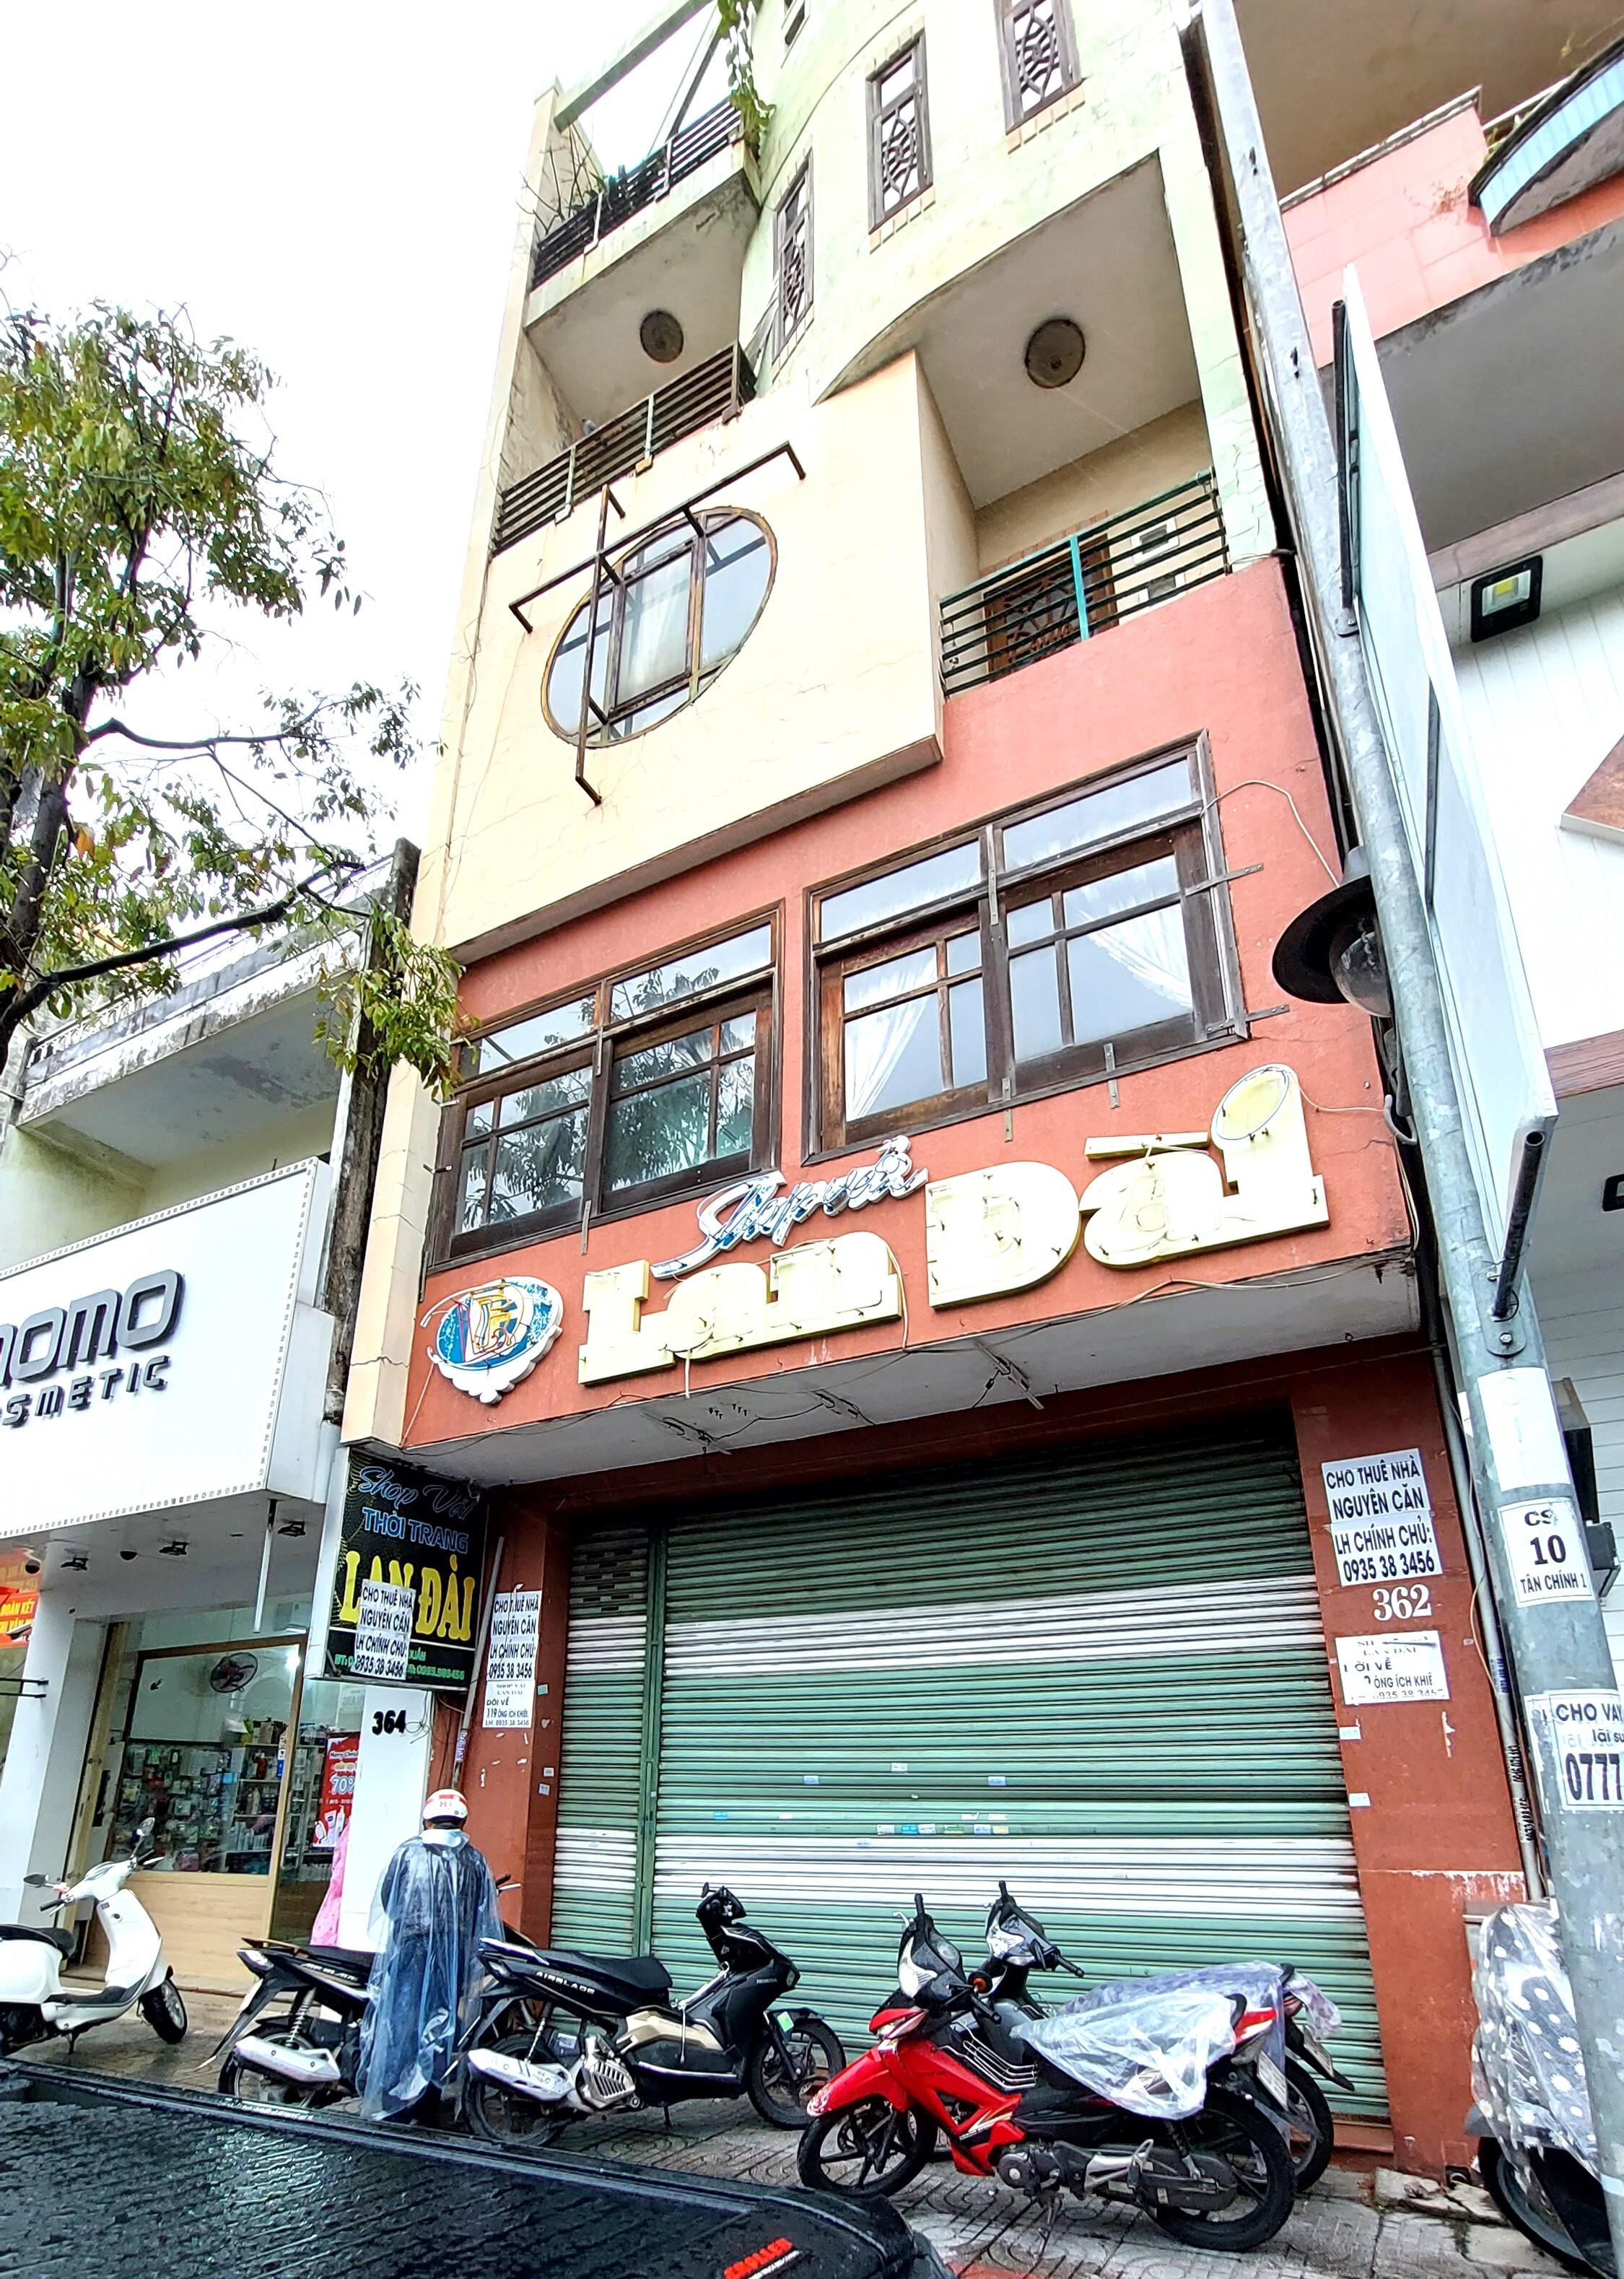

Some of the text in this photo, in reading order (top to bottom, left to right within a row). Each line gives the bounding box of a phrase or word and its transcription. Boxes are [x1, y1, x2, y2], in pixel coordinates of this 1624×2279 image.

[0, 1269, 185, 1389] OMO
[0, 1355, 170, 1427] SMETIC
[1326, 1455, 1420, 1489] CHO THUÊ NHÀ
[359, 1466, 419, 1509] Shop
[1332, 1483, 1425, 1520] NGUYÊN CĂN
[362, 1503, 469, 1554] THỜI TRANG
[1335, 1515, 1433, 1555] LH CHÍNH CHỦ:
[1530, 1535, 1566, 1565] 10
[1343, 1550, 1435, 1582] 0935 38 3456
[1520, 1569, 1587, 1594] TÂN CHÍNH 1
[362, 1587, 413, 1609] CHO THUÊ NHÀ
[415, 1554, 476, 1641] ĐÀI
[494, 1600, 508, 1613] CHO
[525, 1594, 538, 1612] NHÀ
[1372, 1584, 1433, 1621] 362
[362, 1608, 411, 1633] NGUYÊN CĂN
[493, 1614, 536, 1636] NGUYÊN CĂN
[356, 1633, 364, 1650] LH
[365, 1633, 388, 1656] CHÍNH
[489, 1643, 498, 1659] LH
[499, 1639, 520, 1659] CHÍNH
[375, 1660, 385, 1676] 38
[385, 1660, 405, 1678] 3456
[489, 1663, 533, 1679] 0935 38 3456
[1374, 1657, 1392, 1671] VỀ
[1374, 1675, 1394, 1688] ÔNG
[1396, 1674, 1412, 1688] ÍCH
[372, 1710, 407, 1735] 364
[487, 1708, 497, 1718] 119
[1555, 1703, 1597, 1722] CHO
[1592, 1728, 1611, 1743] lãi
[1566, 1753, 1623, 1800] 0777
